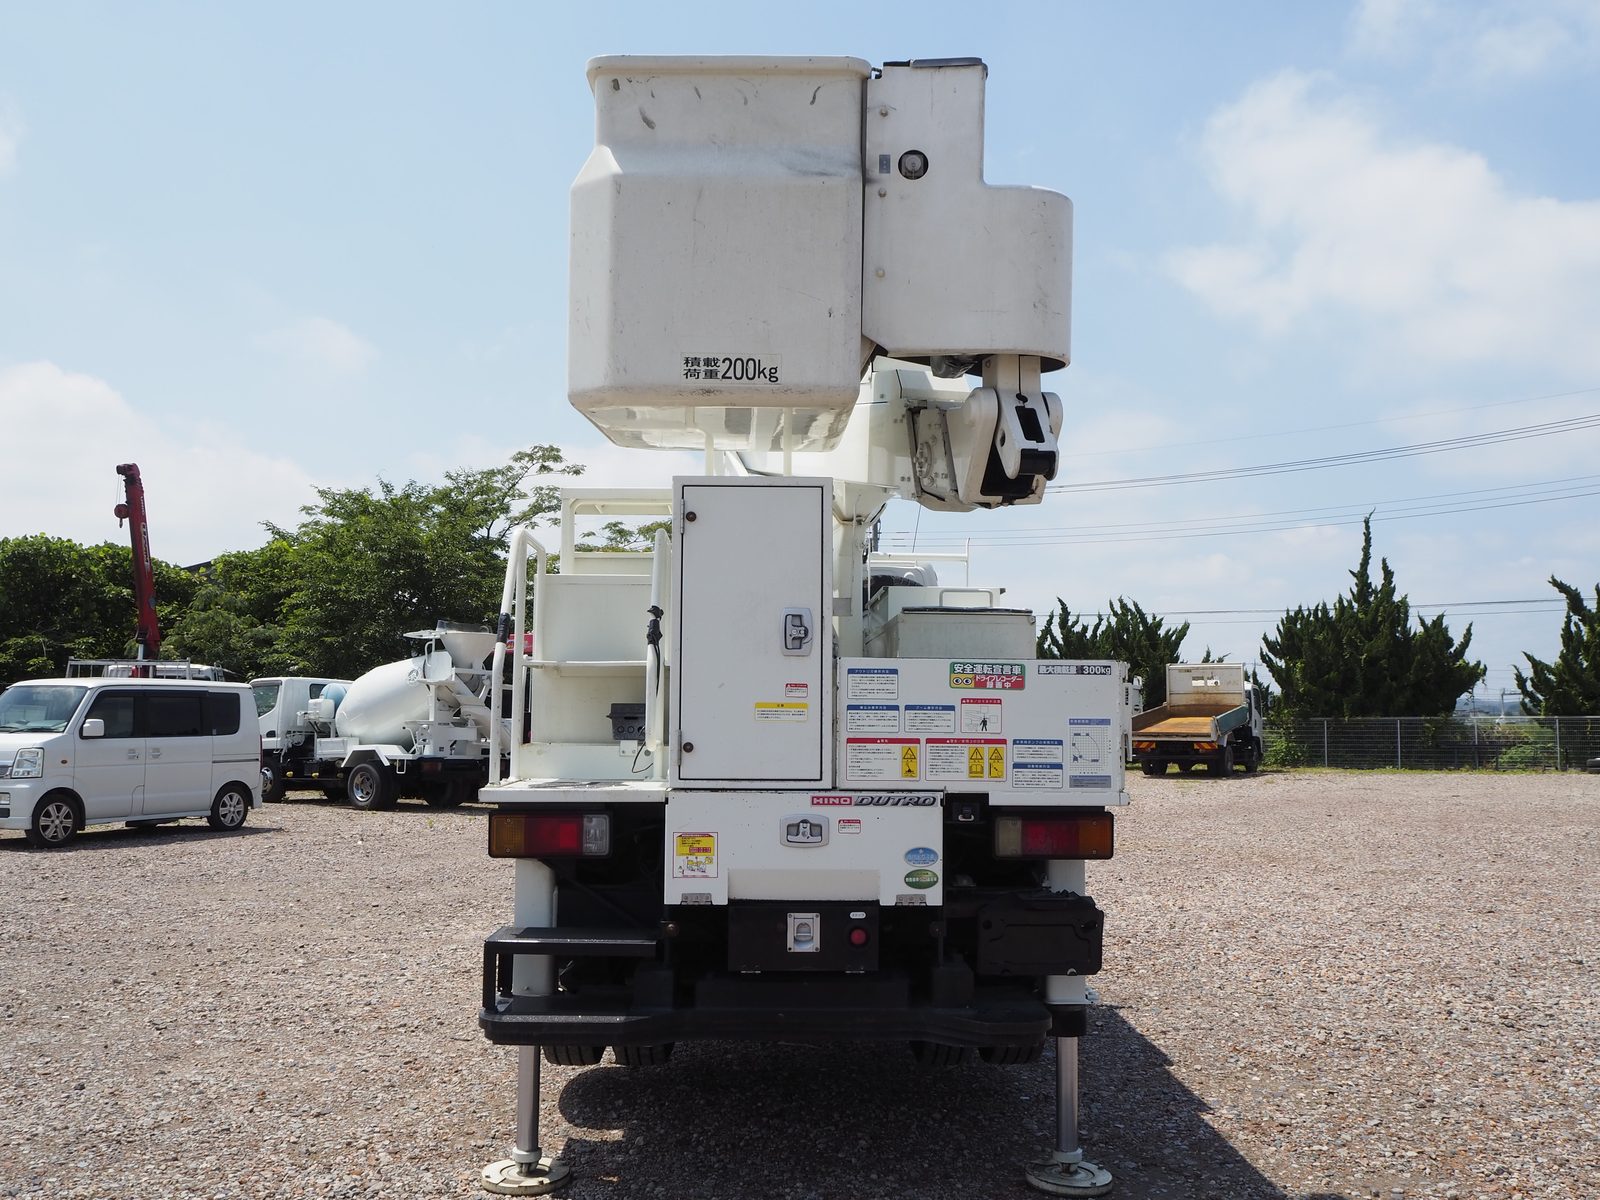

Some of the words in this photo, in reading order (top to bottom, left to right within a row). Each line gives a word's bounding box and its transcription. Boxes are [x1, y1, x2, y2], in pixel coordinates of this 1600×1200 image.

[683, 356, 720, 368] 積載
[683, 368, 720, 380] 荷重
[721, 357, 779, 383] 200kg
[953, 663, 1022, 675] 安全運転宣言車
[1083, 665, 1111, 675] 300kg
[975, 675, 1023, 683] ドライブレコーダー
[812, 796, 852, 805] HINO
[854, 795, 938, 807] DUTRO
